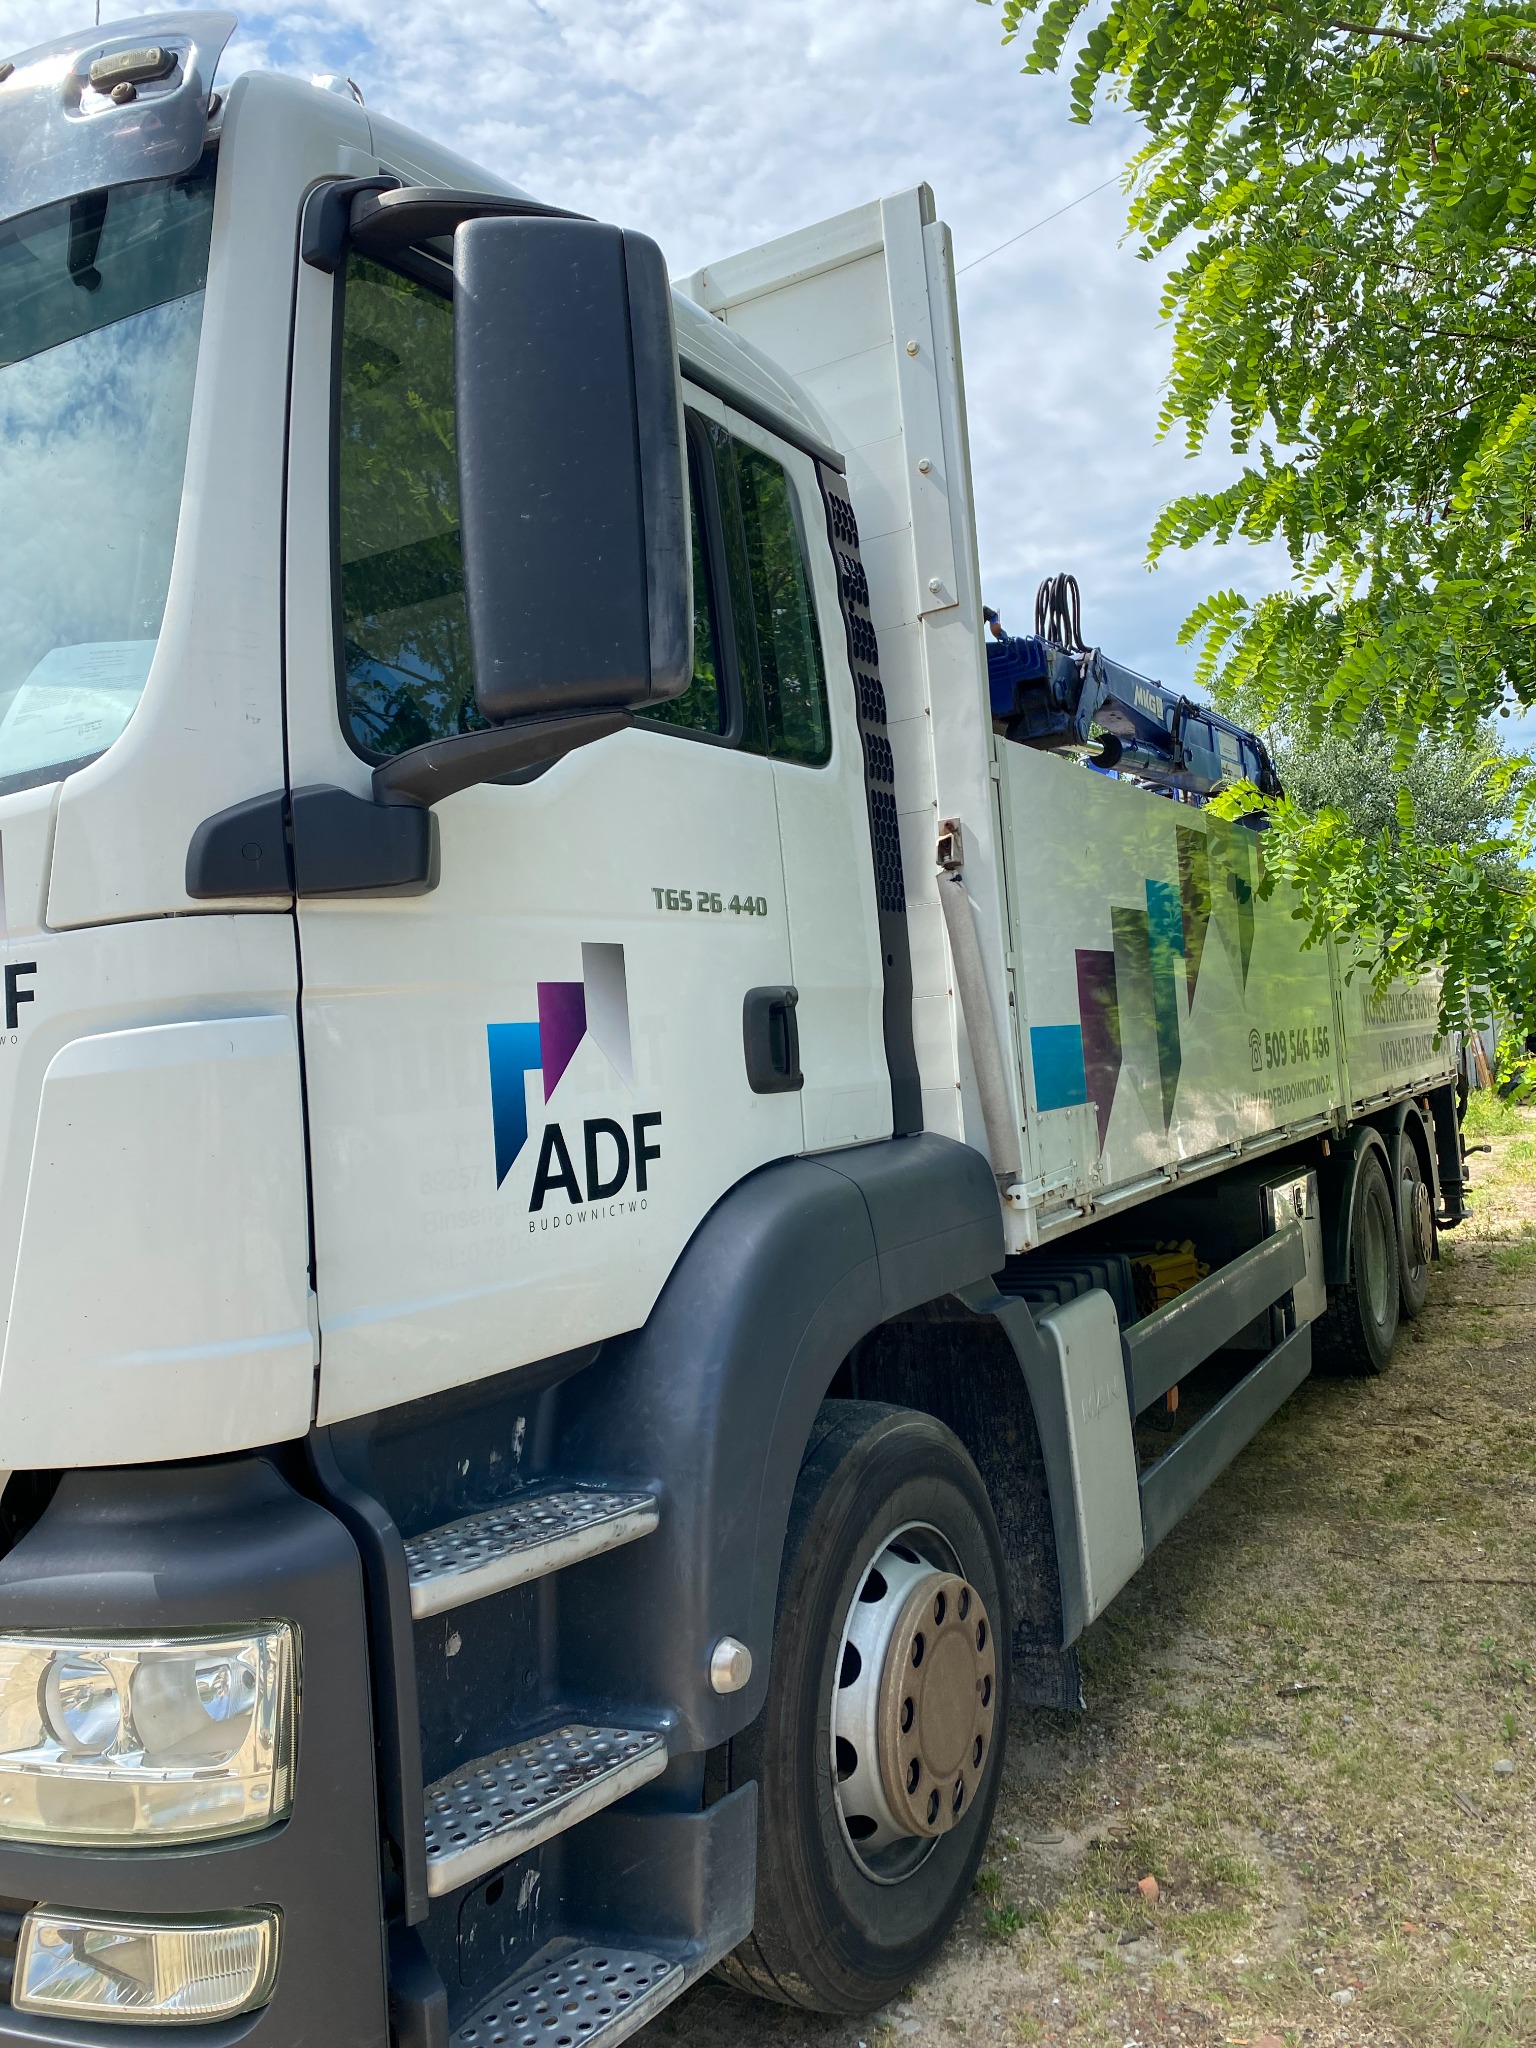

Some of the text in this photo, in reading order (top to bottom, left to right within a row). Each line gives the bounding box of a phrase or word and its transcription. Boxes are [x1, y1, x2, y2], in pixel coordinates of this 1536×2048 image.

[652, 887, 768, 916] TGS 26.440
[1264, 1026, 1330, 1069] 509 546 456
[528, 1110, 662, 1213] ADF
[528, 1198, 648, 1233] BUDOWNICTWO
